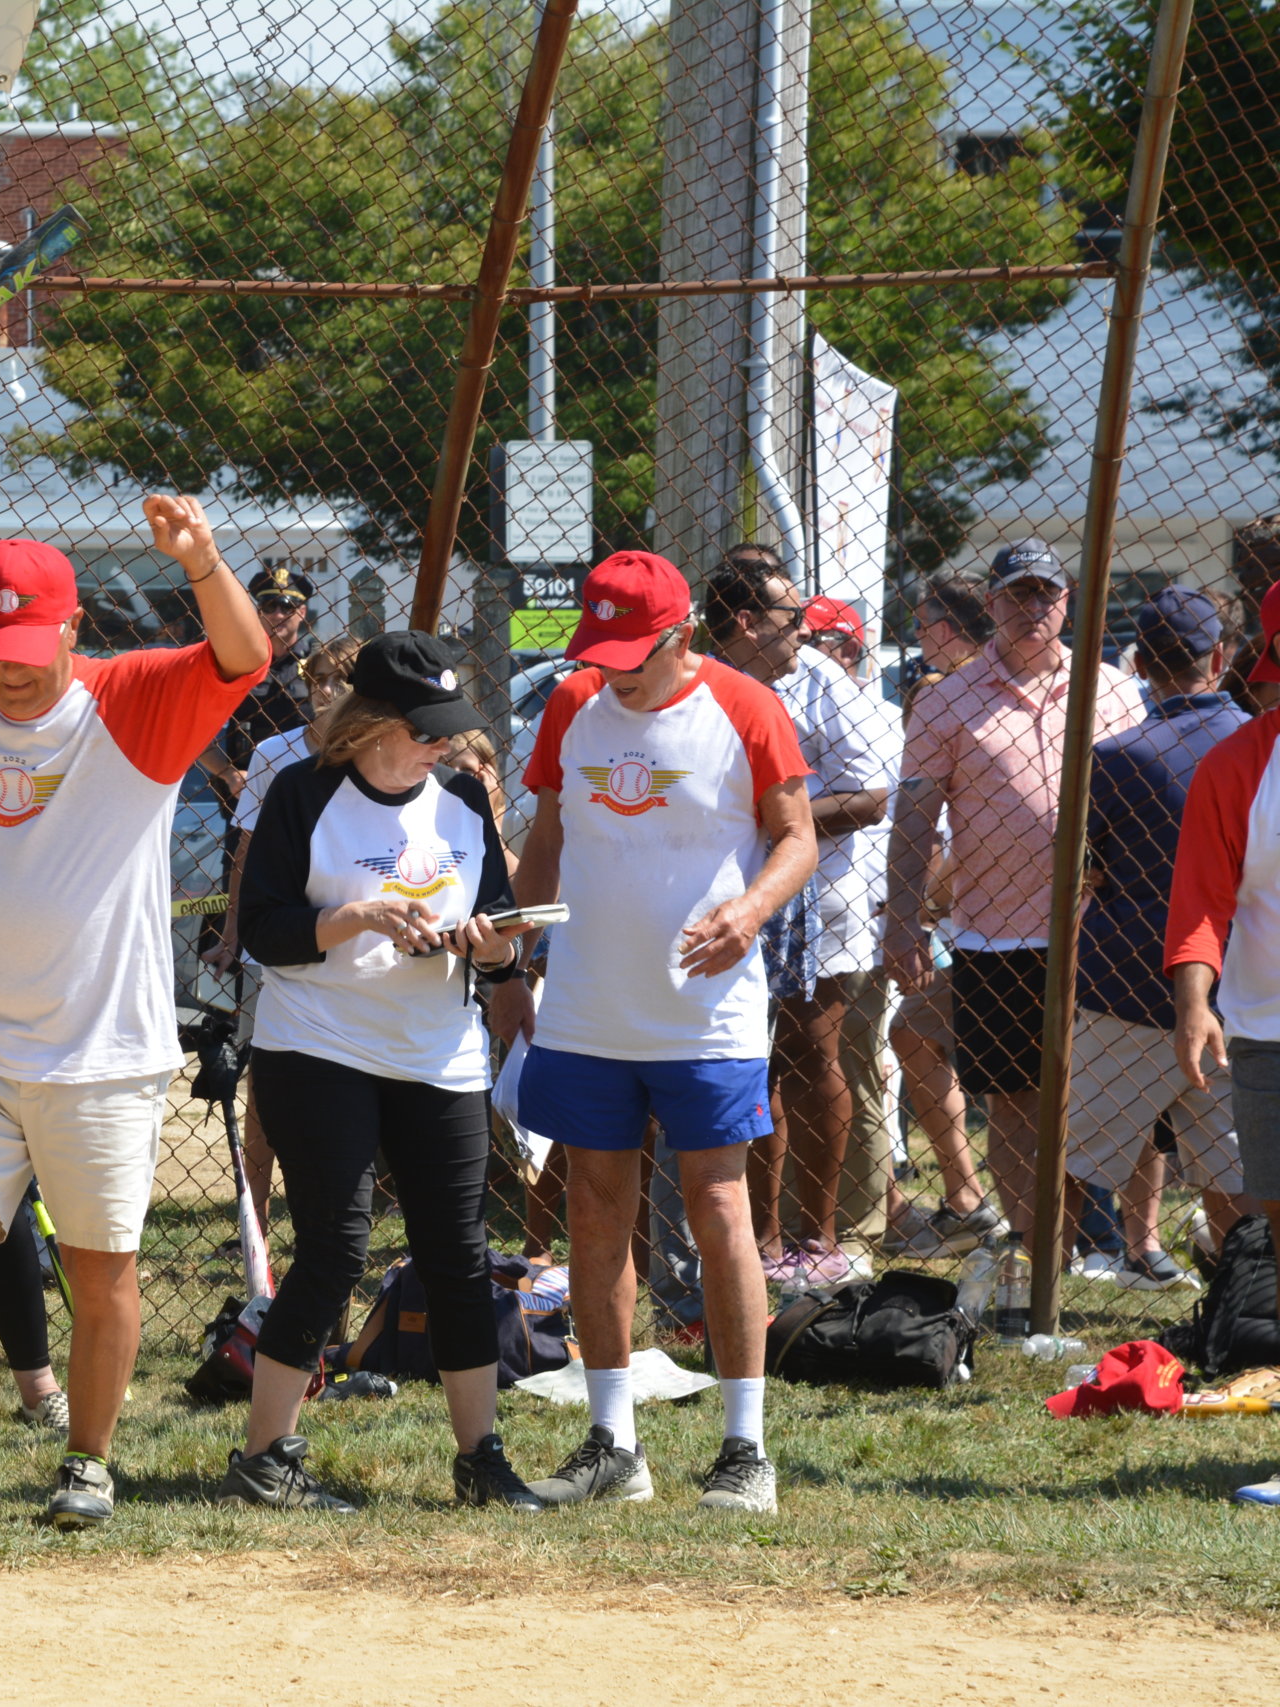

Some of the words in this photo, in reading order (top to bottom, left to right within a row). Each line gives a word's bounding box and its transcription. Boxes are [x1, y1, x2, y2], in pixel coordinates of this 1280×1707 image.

[523, 574, 575, 596] 59101
[3, 756, 26, 765] 2022
[624, 751, 645, 759] 2022
[181, 898, 228, 915] CUIDAD
